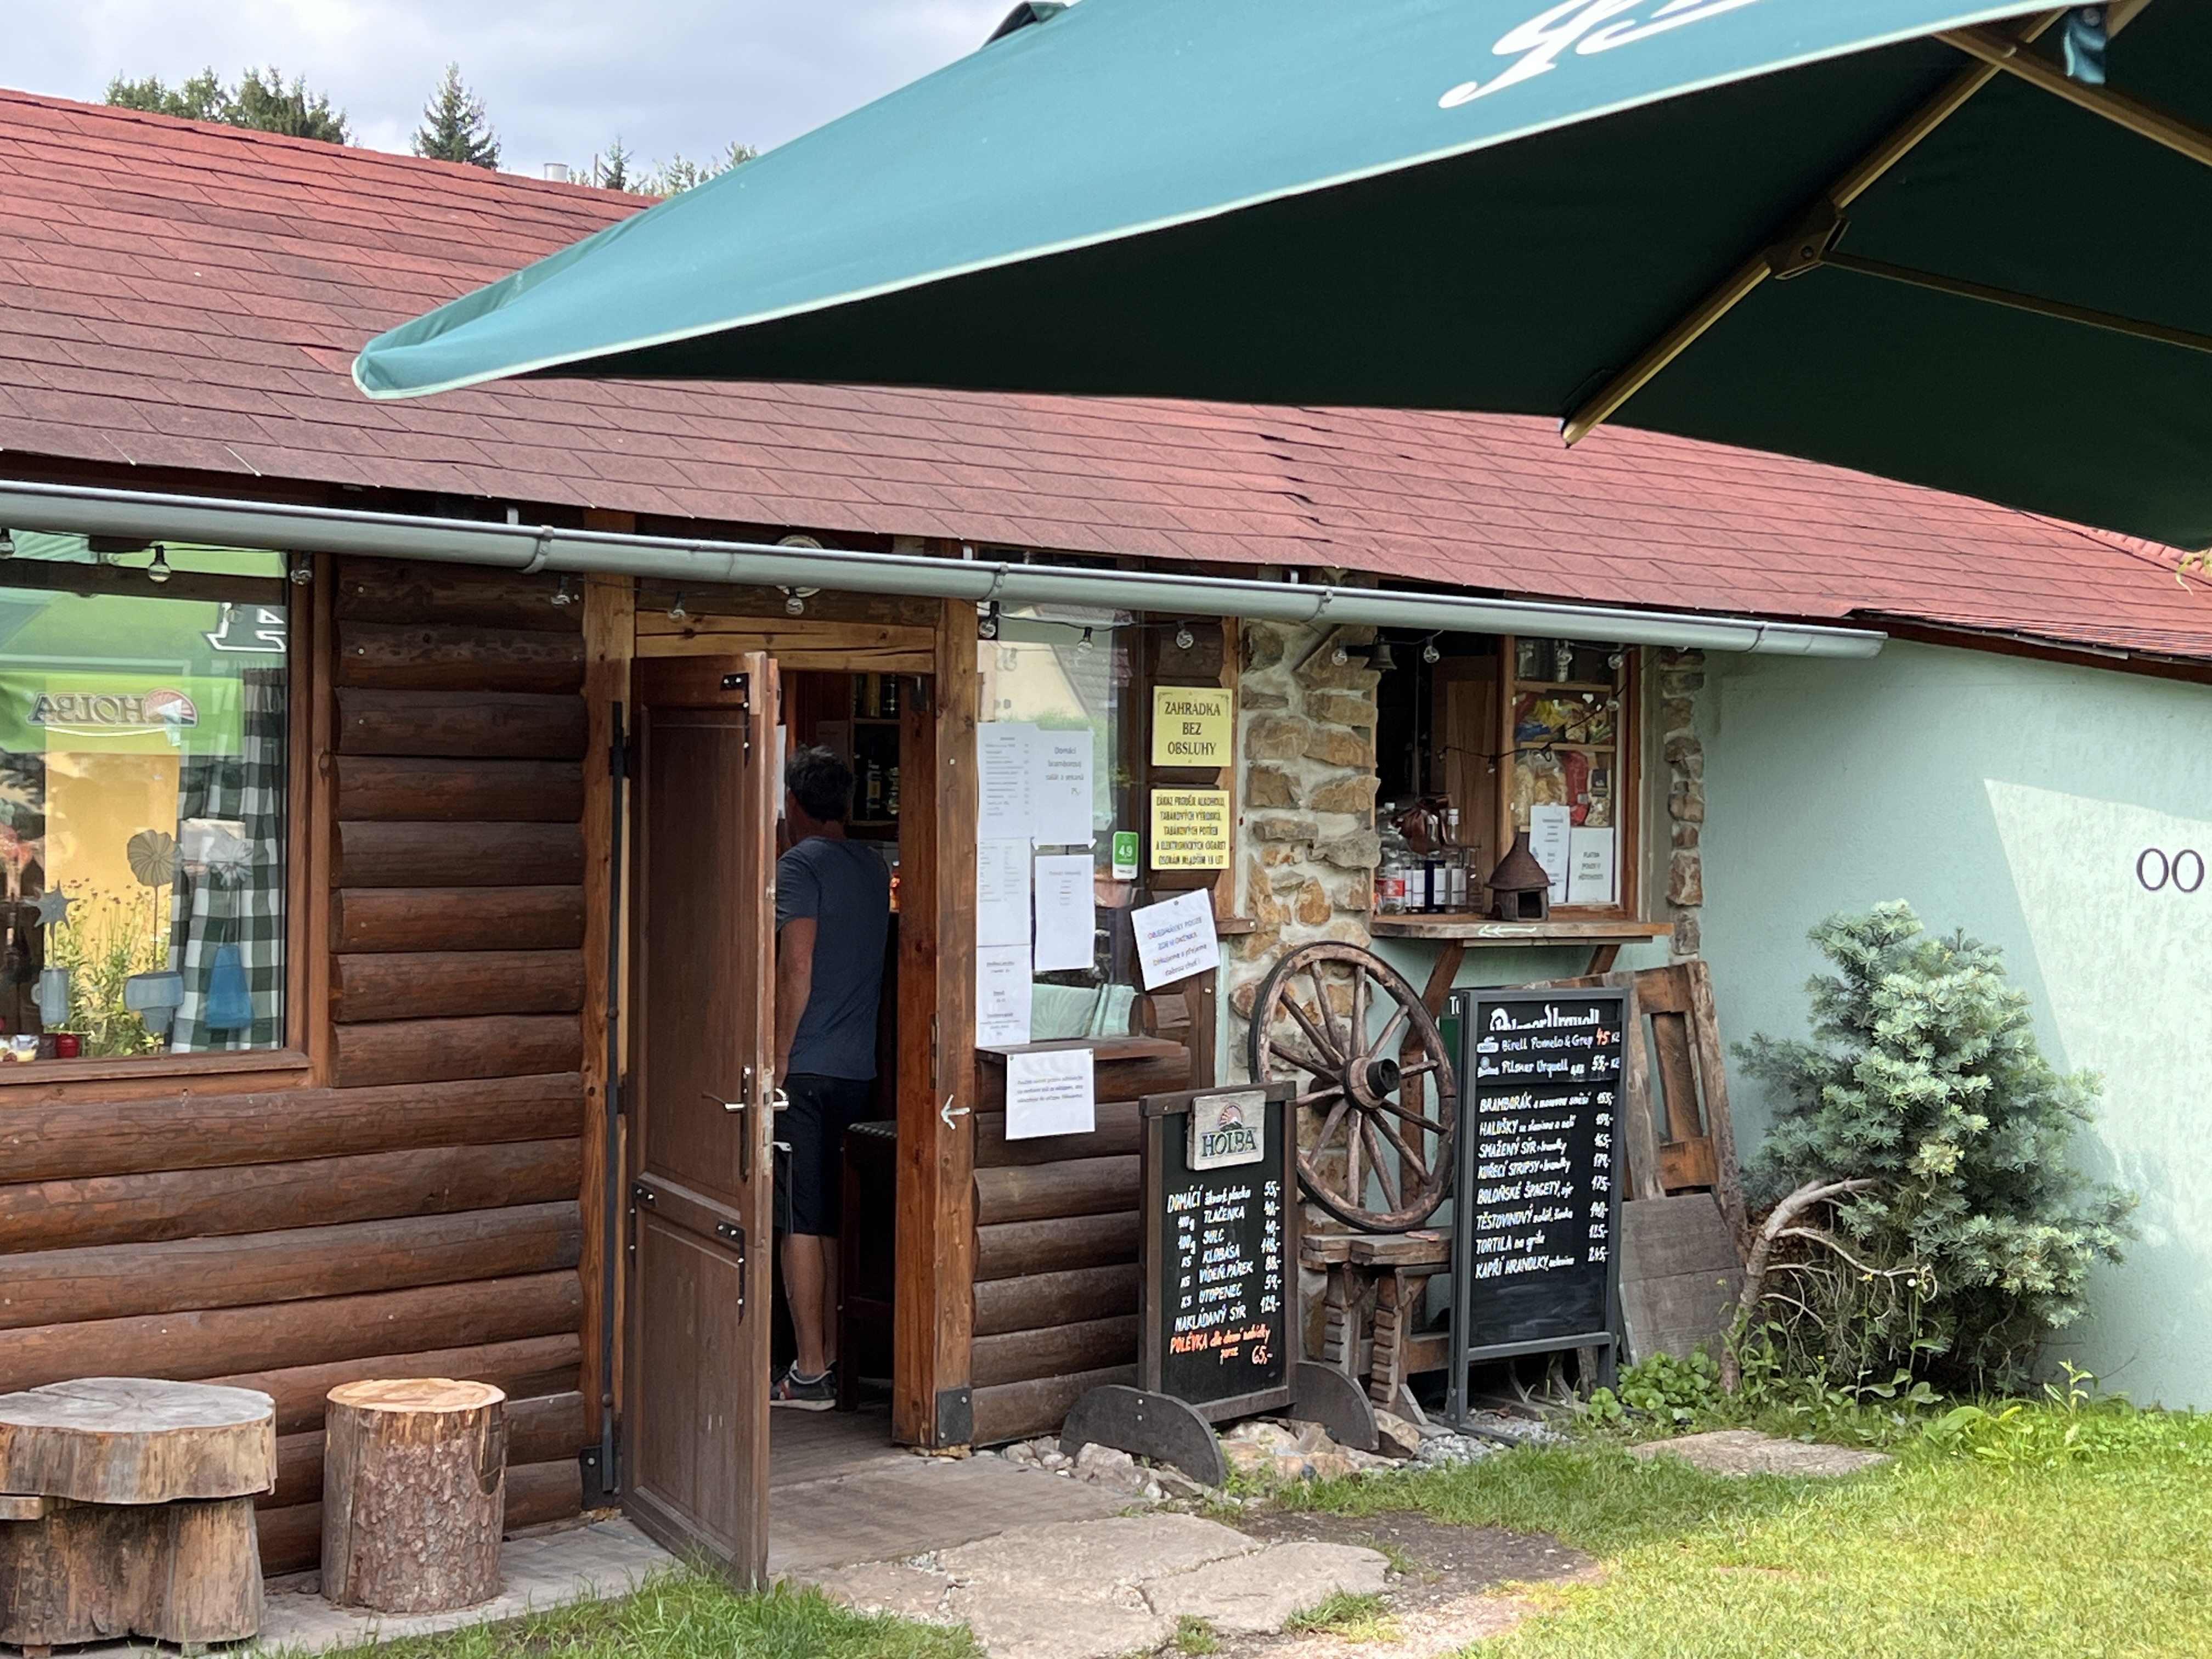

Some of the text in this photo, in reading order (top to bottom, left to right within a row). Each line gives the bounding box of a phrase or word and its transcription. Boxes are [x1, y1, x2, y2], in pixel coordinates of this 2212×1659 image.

[1182, 722, 1201, 735] BEZ
[1167, 741, 1216, 755] OBSLUHY
[1502, 1059, 1534, 1074] Pilsner
[1537, 1058, 1568, 1079] Urquell
[1480, 1091, 1532, 1113] BRAMBORÁK
[1479, 1117, 1519, 1136] HALUŠKY
[1201, 1130, 1257, 1157] HOLBA
[1477, 1136, 1520, 1159] SMAŽENÝ
[1167, 1184, 1204, 1214] DOMÁCÍ
[1204, 1206, 1245, 1223] TLAČENKA
[1202, 1241, 1240, 1264] KLOBÁSA
[1475, 1234, 1513, 1255] TORTILA
[1475, 1255, 1506, 1279] KAPŘÍ
[1199, 1282, 1243, 1304] UTOPENEC
[1175, 1303, 1227, 1332] NAKLÁDANÝ
[1229, 1300, 1247, 1322] SÝR
[1169, 1331, 1208, 1355] POLÉVKA
